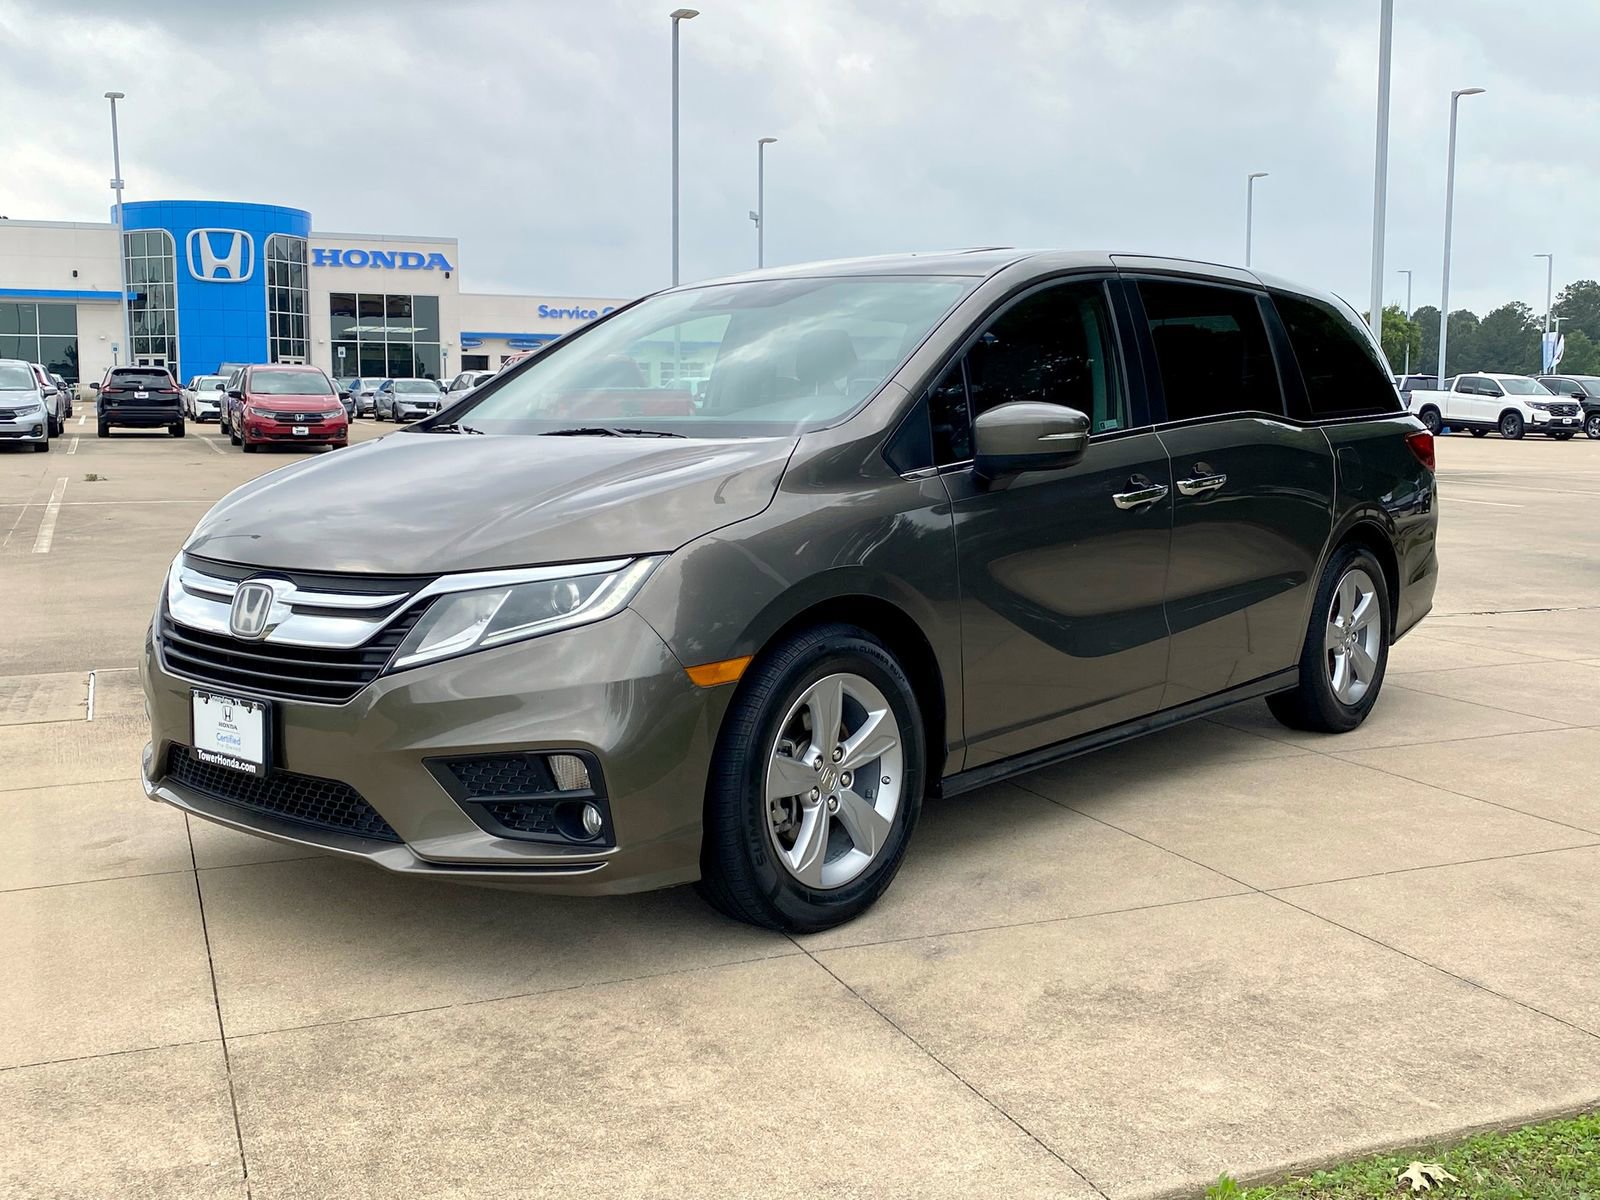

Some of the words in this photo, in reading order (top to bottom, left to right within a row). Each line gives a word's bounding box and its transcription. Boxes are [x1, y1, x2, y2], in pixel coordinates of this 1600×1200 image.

[311, 248, 454, 271] HONDA
[538, 304, 598, 319] Service
[218, 721, 238, 730] HONDA
[216, 732, 241, 746] Certified
[197, 749, 256, 773] TowerHonda.com
